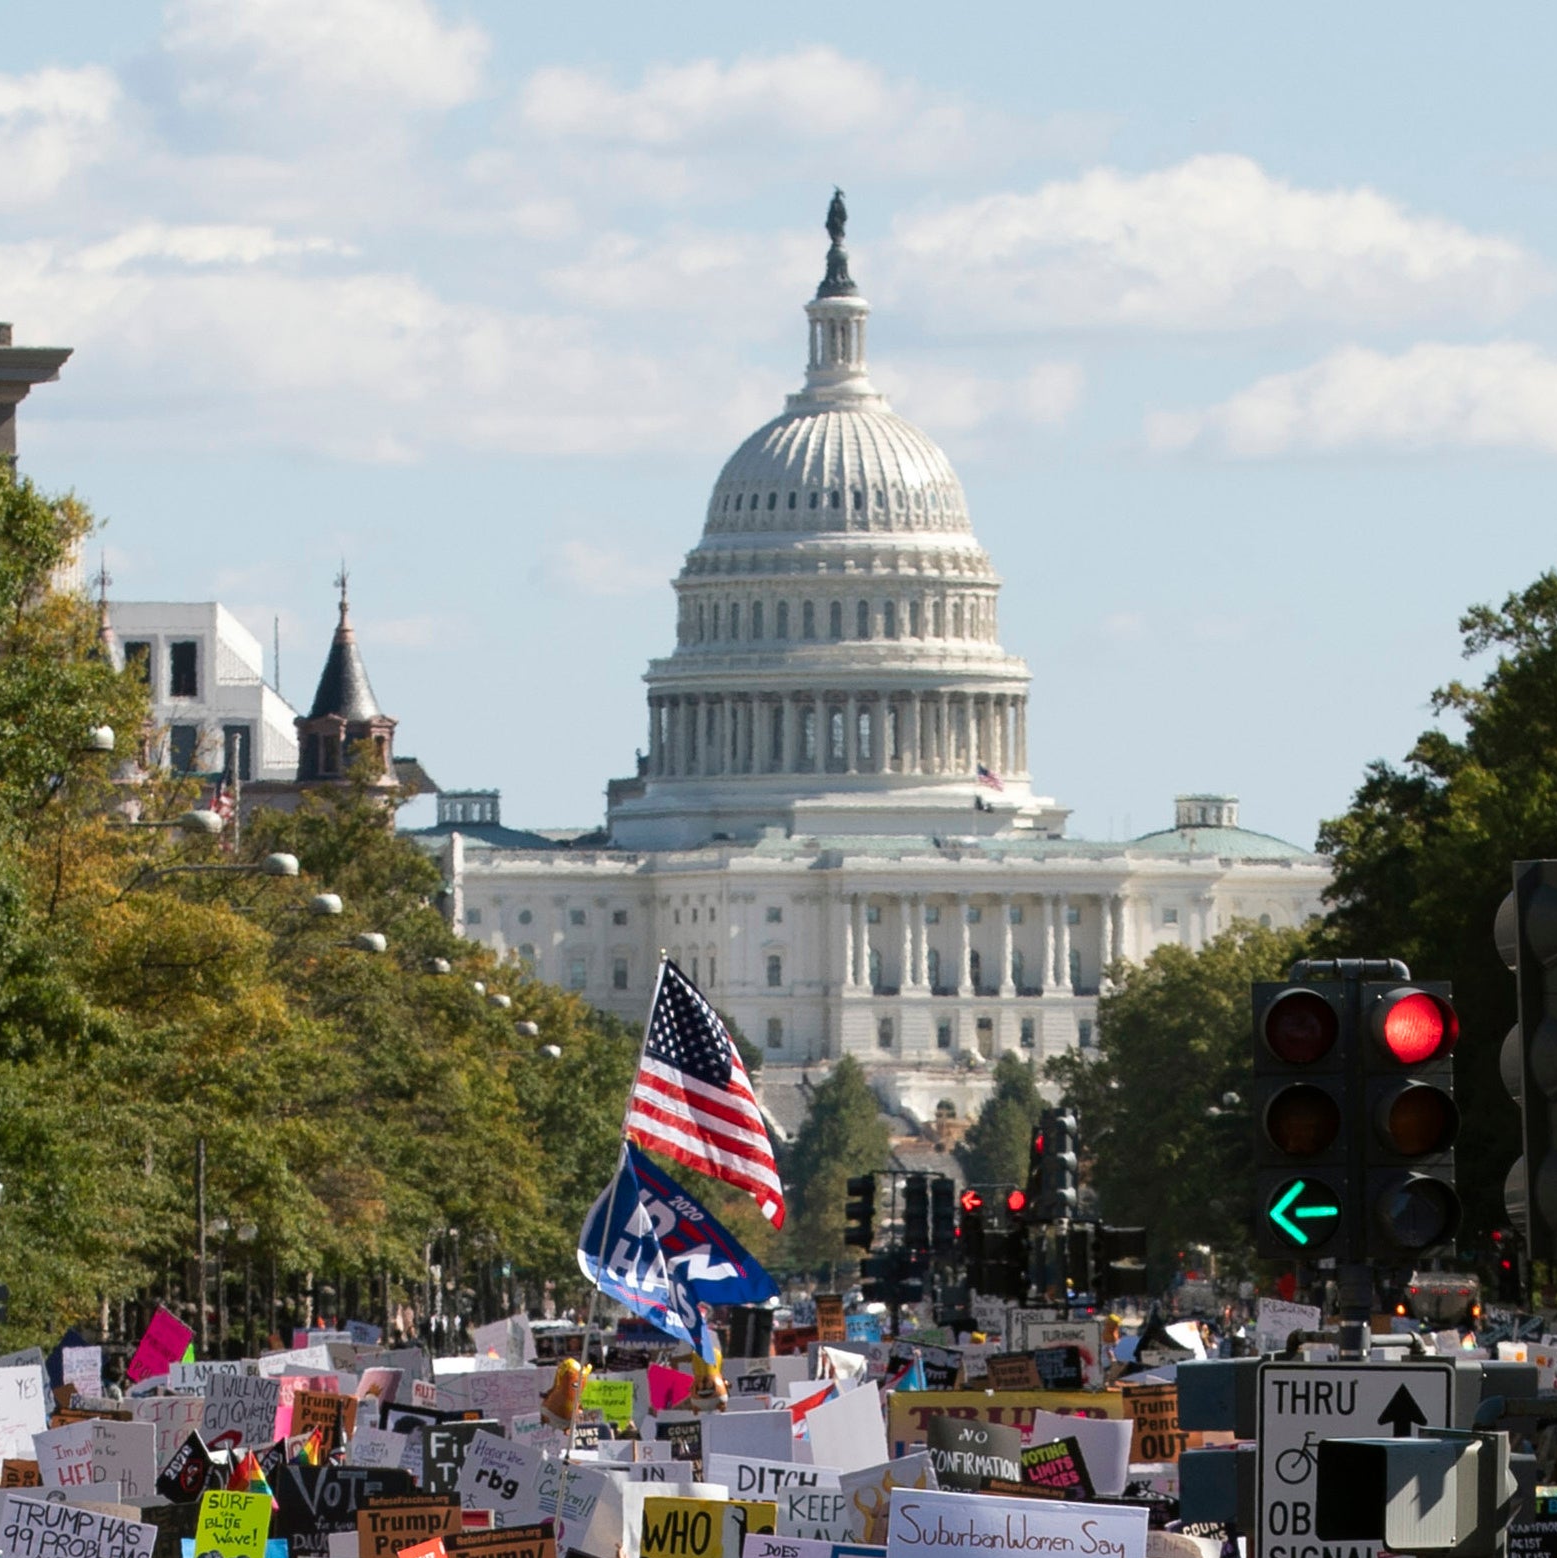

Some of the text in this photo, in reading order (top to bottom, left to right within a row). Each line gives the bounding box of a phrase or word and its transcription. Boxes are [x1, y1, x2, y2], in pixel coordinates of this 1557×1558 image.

[1272, 1380, 1356, 1415] THRU
[958, 1429, 987, 1442] NO
[931, 1448, 1020, 1479] CONFIRMATION
[209, 1495, 255, 1511] SURF
[204, 1517, 241, 1530] BLUE
[897, 1504, 1006, 1550] Suburban
[1006, 1514, 1076, 1550] Women
[213, 1530, 259, 1546] Wave!
[642, 1510, 711, 1555] WHO
[758, 1542, 800, 1558] DOES
